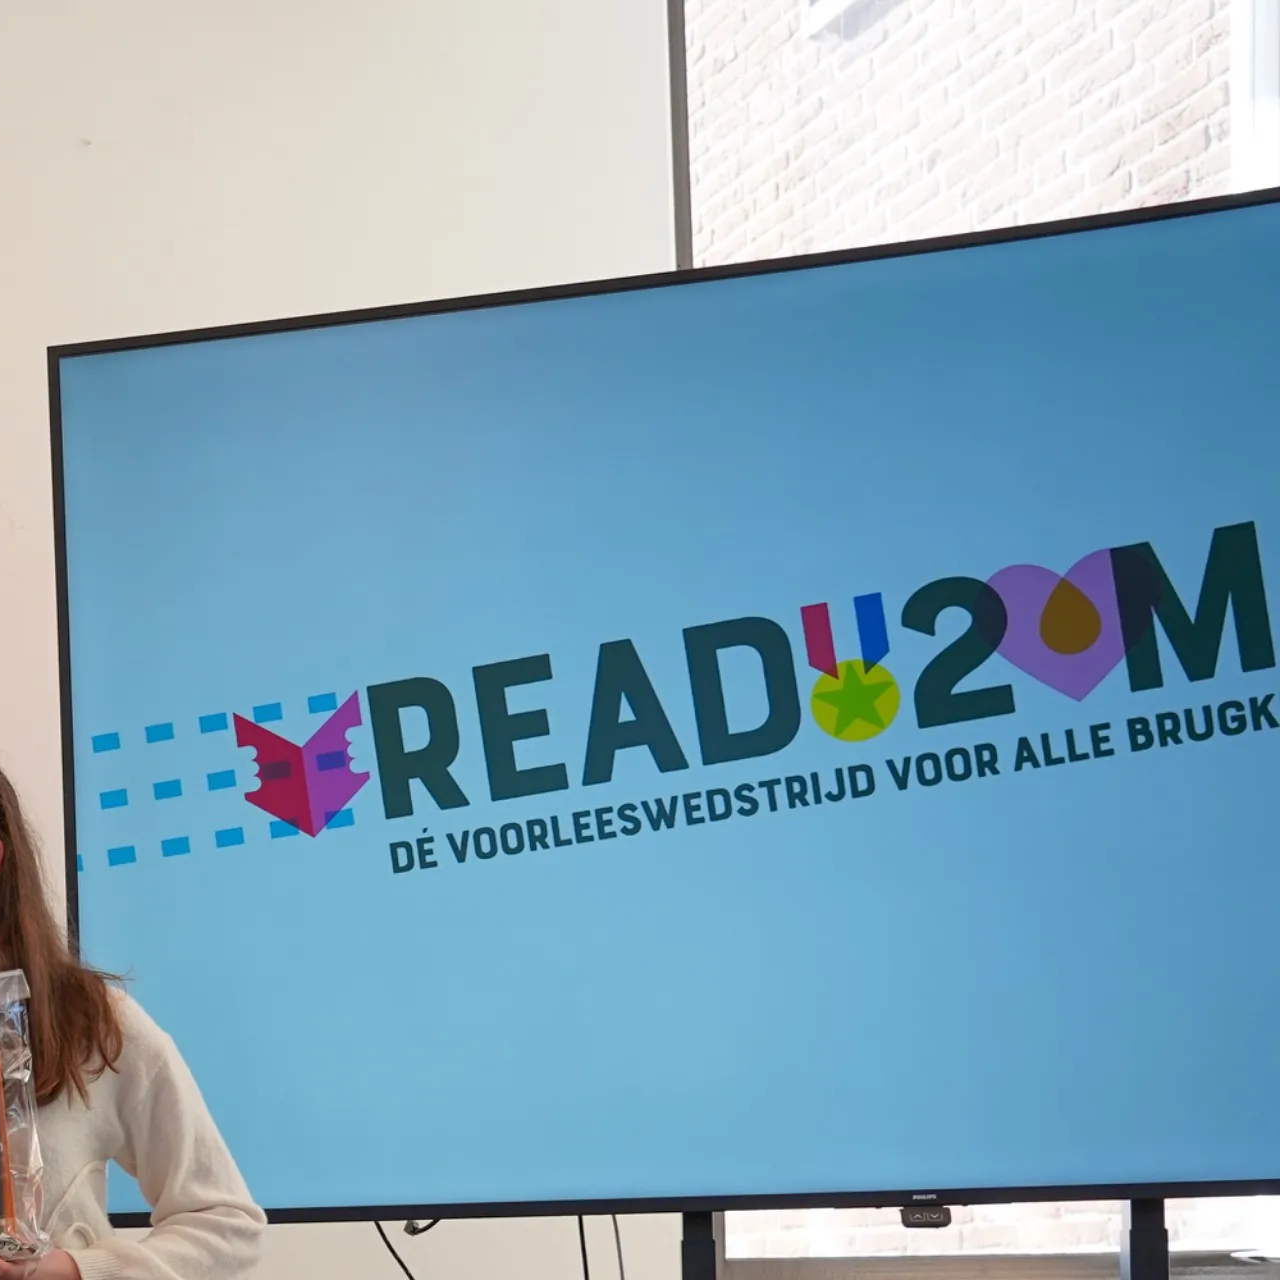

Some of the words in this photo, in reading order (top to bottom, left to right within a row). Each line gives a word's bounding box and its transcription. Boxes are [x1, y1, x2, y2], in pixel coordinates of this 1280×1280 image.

[366, 616, 802, 819] READ
[389, 827, 439, 874] DÉ
[446, 763, 876, 864] VOORLEESWEDSTRIJD
[886, 742, 1001, 791] VOOR
[1014, 722, 1115, 771] ALLE
[1126, 692, 1280, 753] BRUGK
